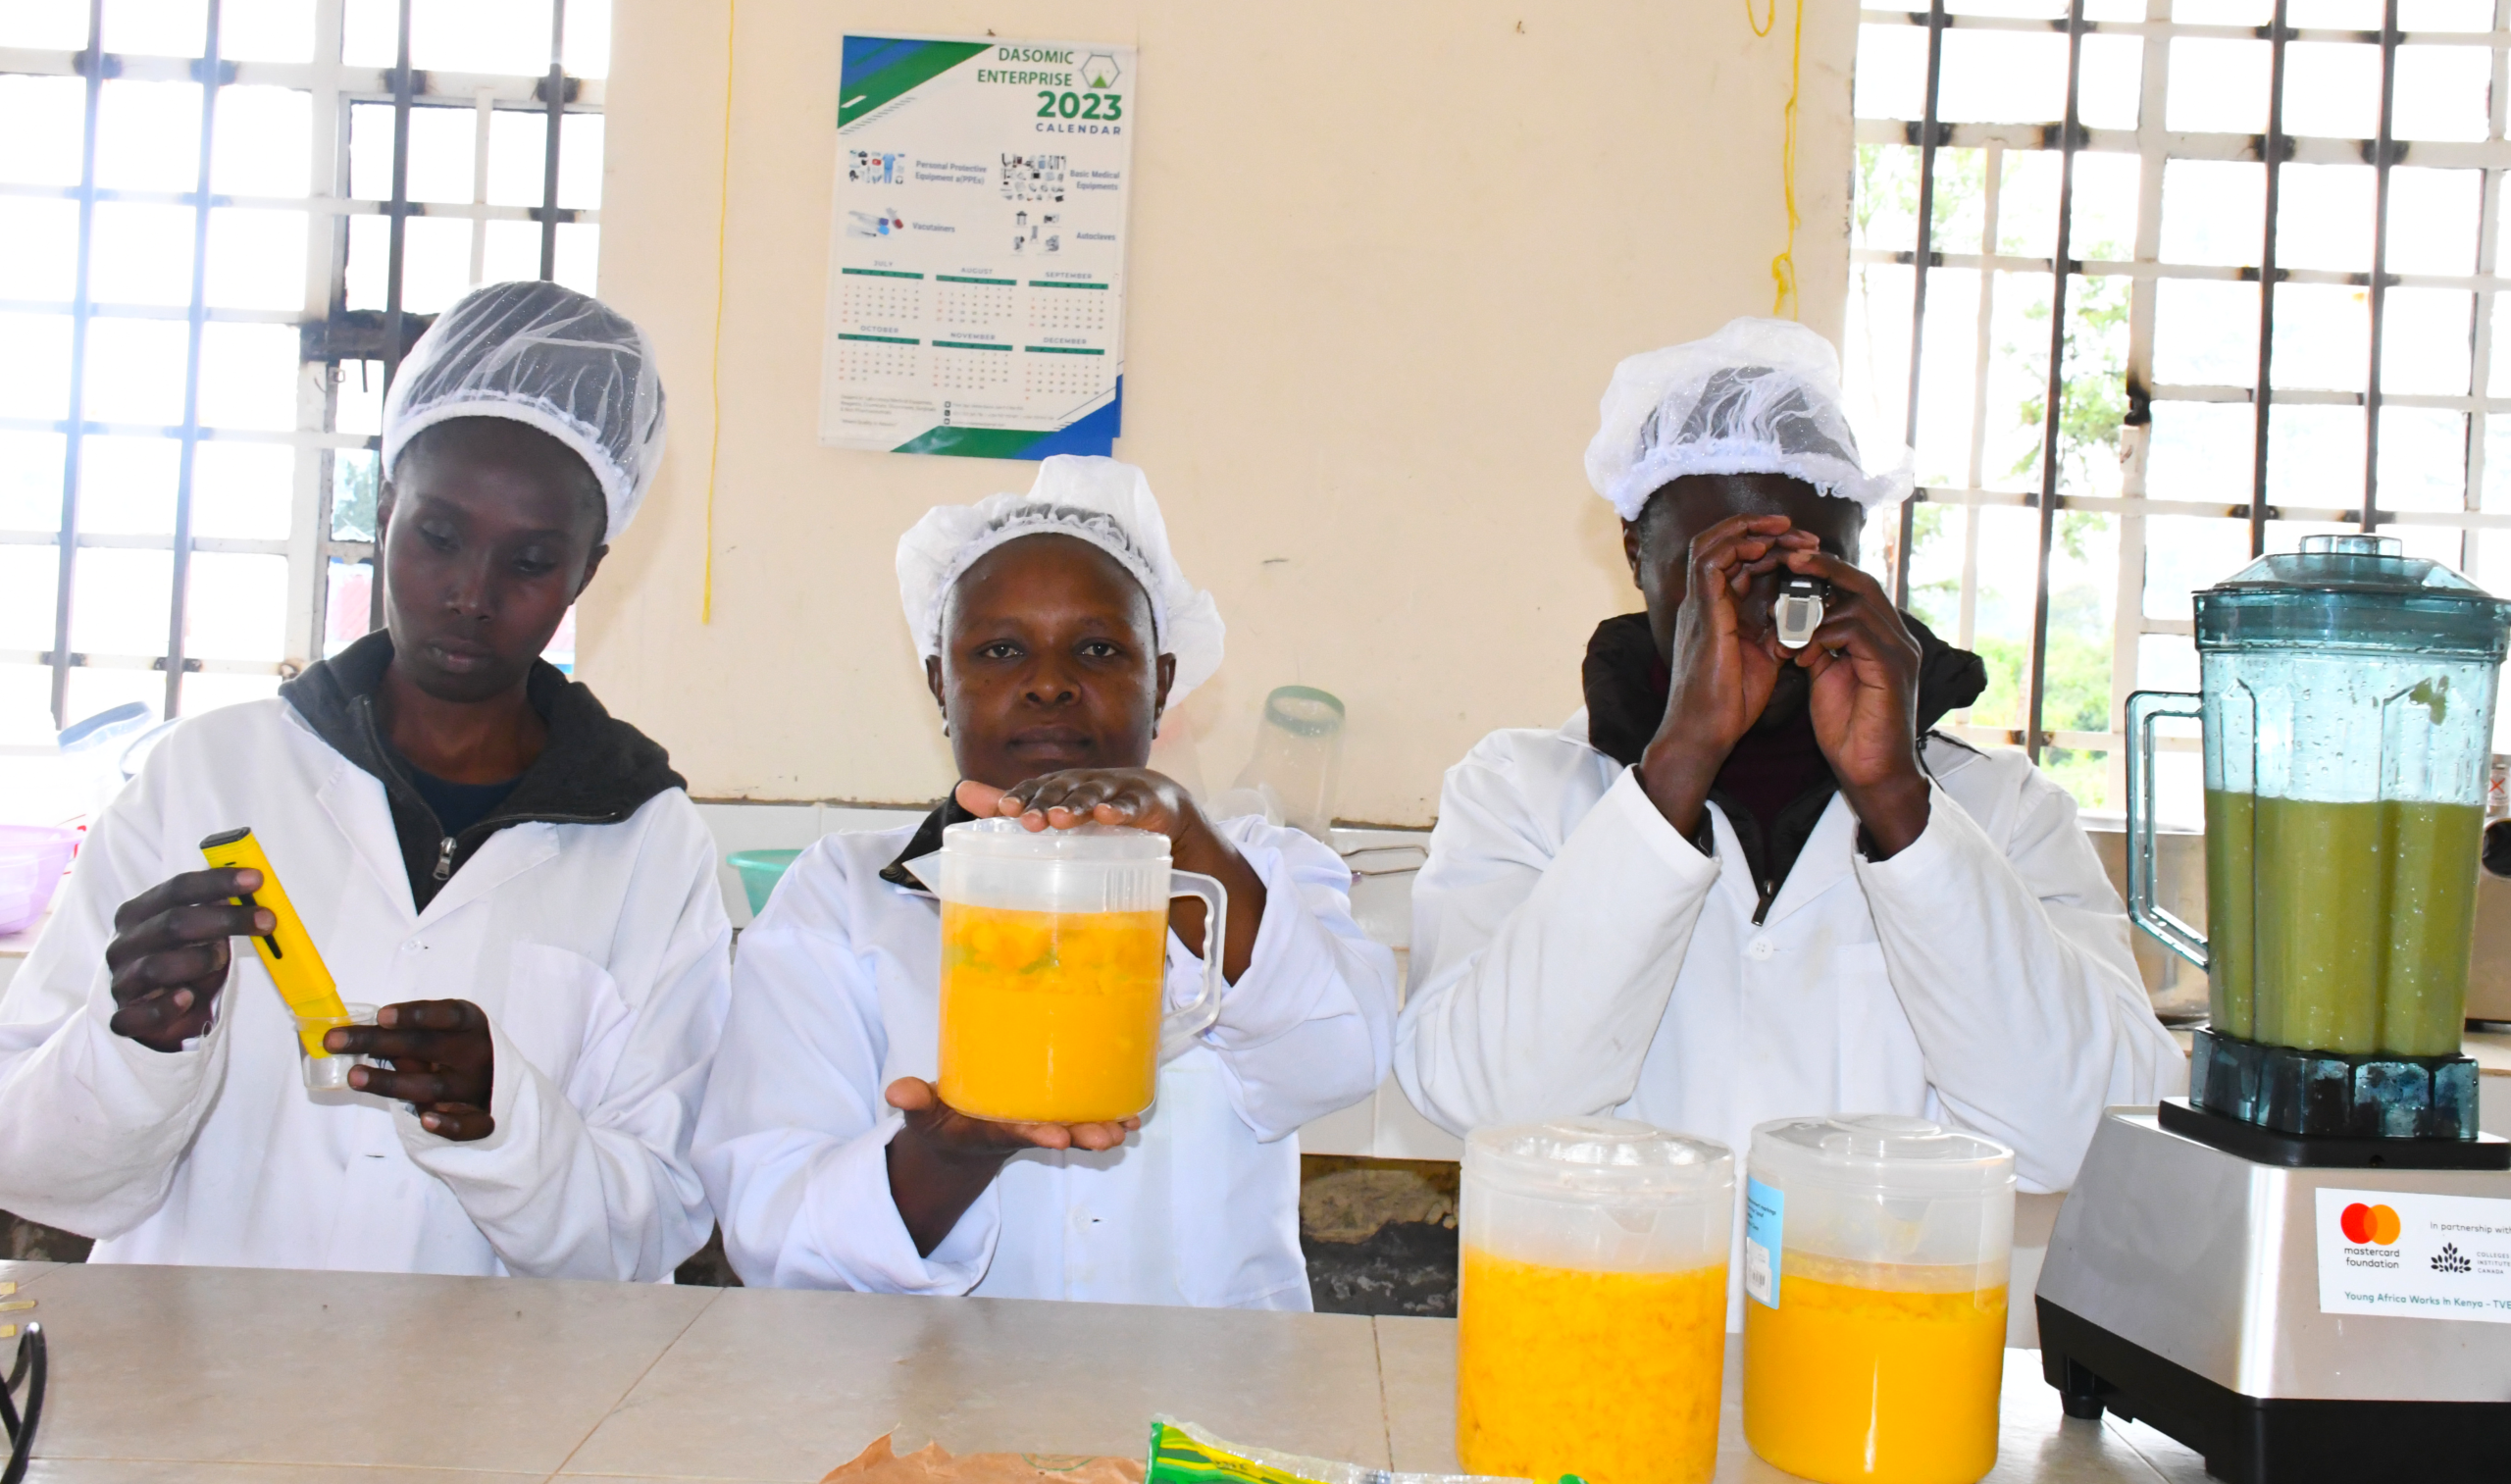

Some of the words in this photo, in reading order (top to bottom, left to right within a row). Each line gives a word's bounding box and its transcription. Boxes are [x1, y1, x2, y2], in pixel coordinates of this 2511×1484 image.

[999, 47, 1074, 65] DASOMIC
[977, 70, 1073, 86] ENTERPRISE
[1036, 90, 1123, 121] 2023
[1035, 123, 1121, 135] CALENDAR
[916, 160, 948, 170] Personal
[950, 163, 988, 173] Protective
[915, 172, 953, 181] Equipment
[912, 222, 955, 232] Vacutainers
[1076, 231, 1116, 240] Autoclaves
[1045, 271, 1093, 280] SEPTEMBER
[860, 325, 899, 333] OCTOBER
[2430, 1221, 2438, 1230] In
[2440, 1223, 2492, 1234] partnership
[2344, 1247, 2400, 1257] mastercard
[2345, 1257, 2400, 1269] foundation
[2344, 1291, 2375, 1304] Young
[2378, 1293, 2407, 1304] Africa
[2409, 1295, 2440, 1305] Works
[2442, 1297, 2451, 1305] in
[2454, 1298, 2484, 1309] Kenya
